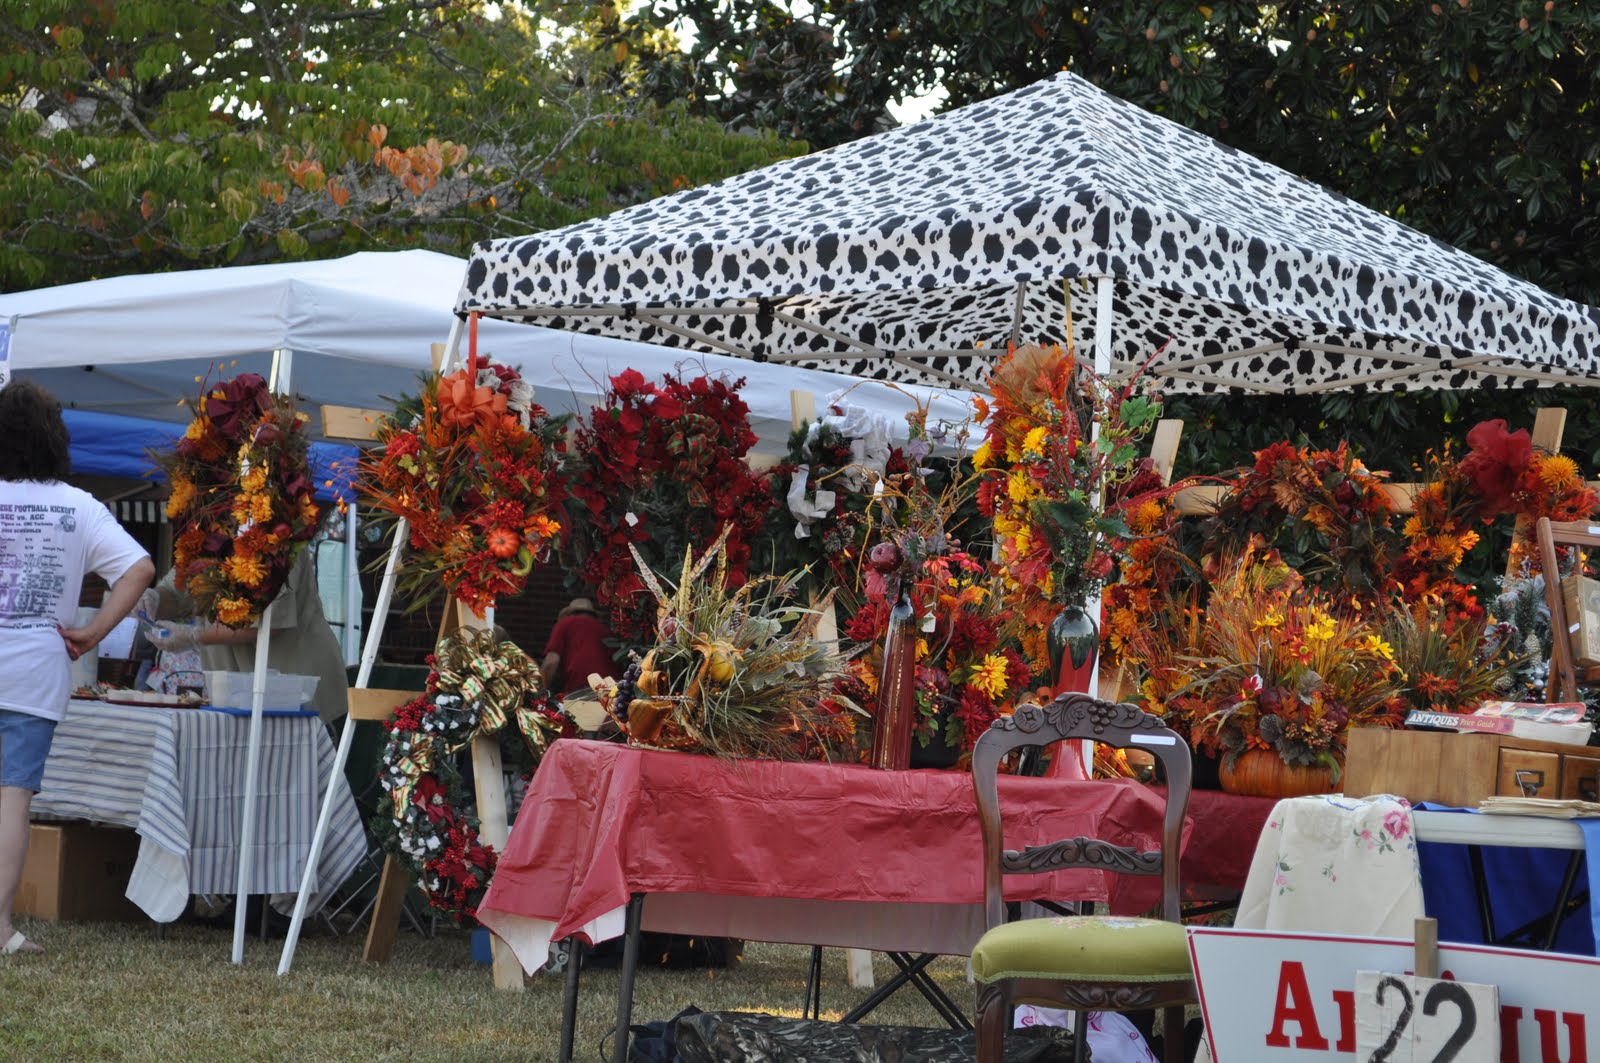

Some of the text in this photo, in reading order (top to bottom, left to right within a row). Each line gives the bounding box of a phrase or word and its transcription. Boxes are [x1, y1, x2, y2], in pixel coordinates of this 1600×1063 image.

[14, 504, 48, 512] FOOTBALL
[50, 505, 76, 515] KICKOFF
[1408, 712, 1496, 729] ANTIQUES Price Guide
